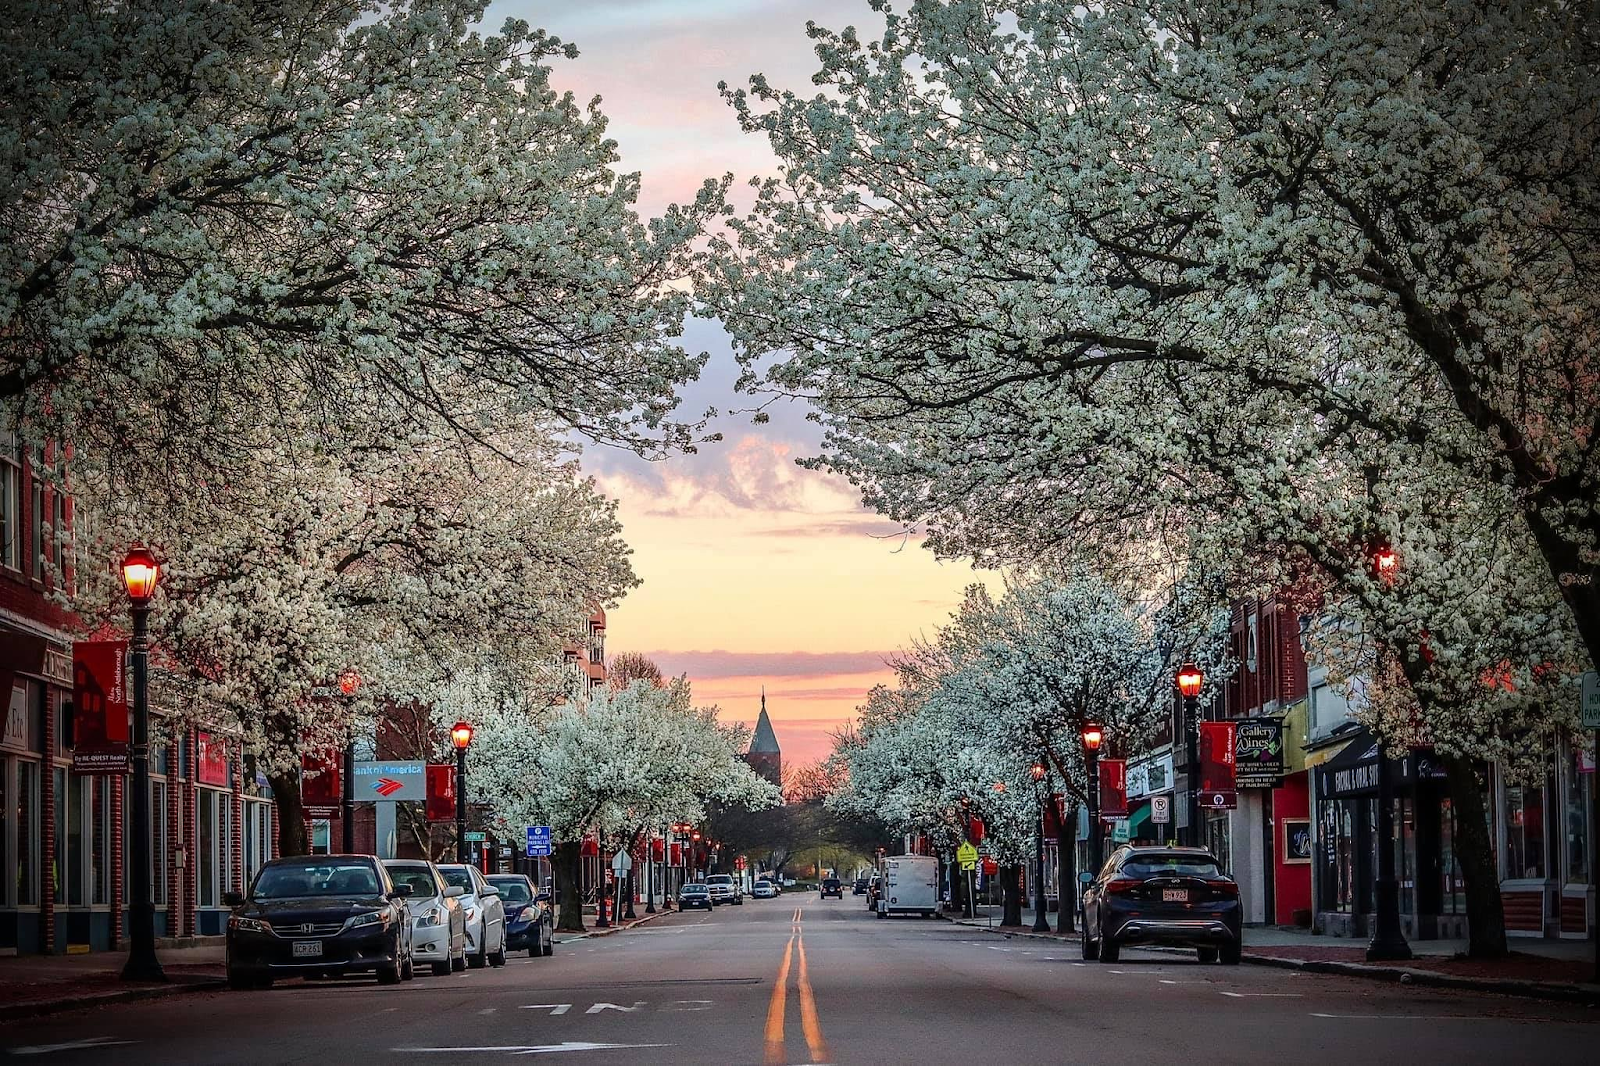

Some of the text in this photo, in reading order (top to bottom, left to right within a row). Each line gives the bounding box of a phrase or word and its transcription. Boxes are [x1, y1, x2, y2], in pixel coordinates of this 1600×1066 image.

[1241, 726, 1274, 738] Gallery
[1236, 737, 1269, 751] Wines
[353, 766, 372, 775] ank
[384, 764, 422, 775] America
